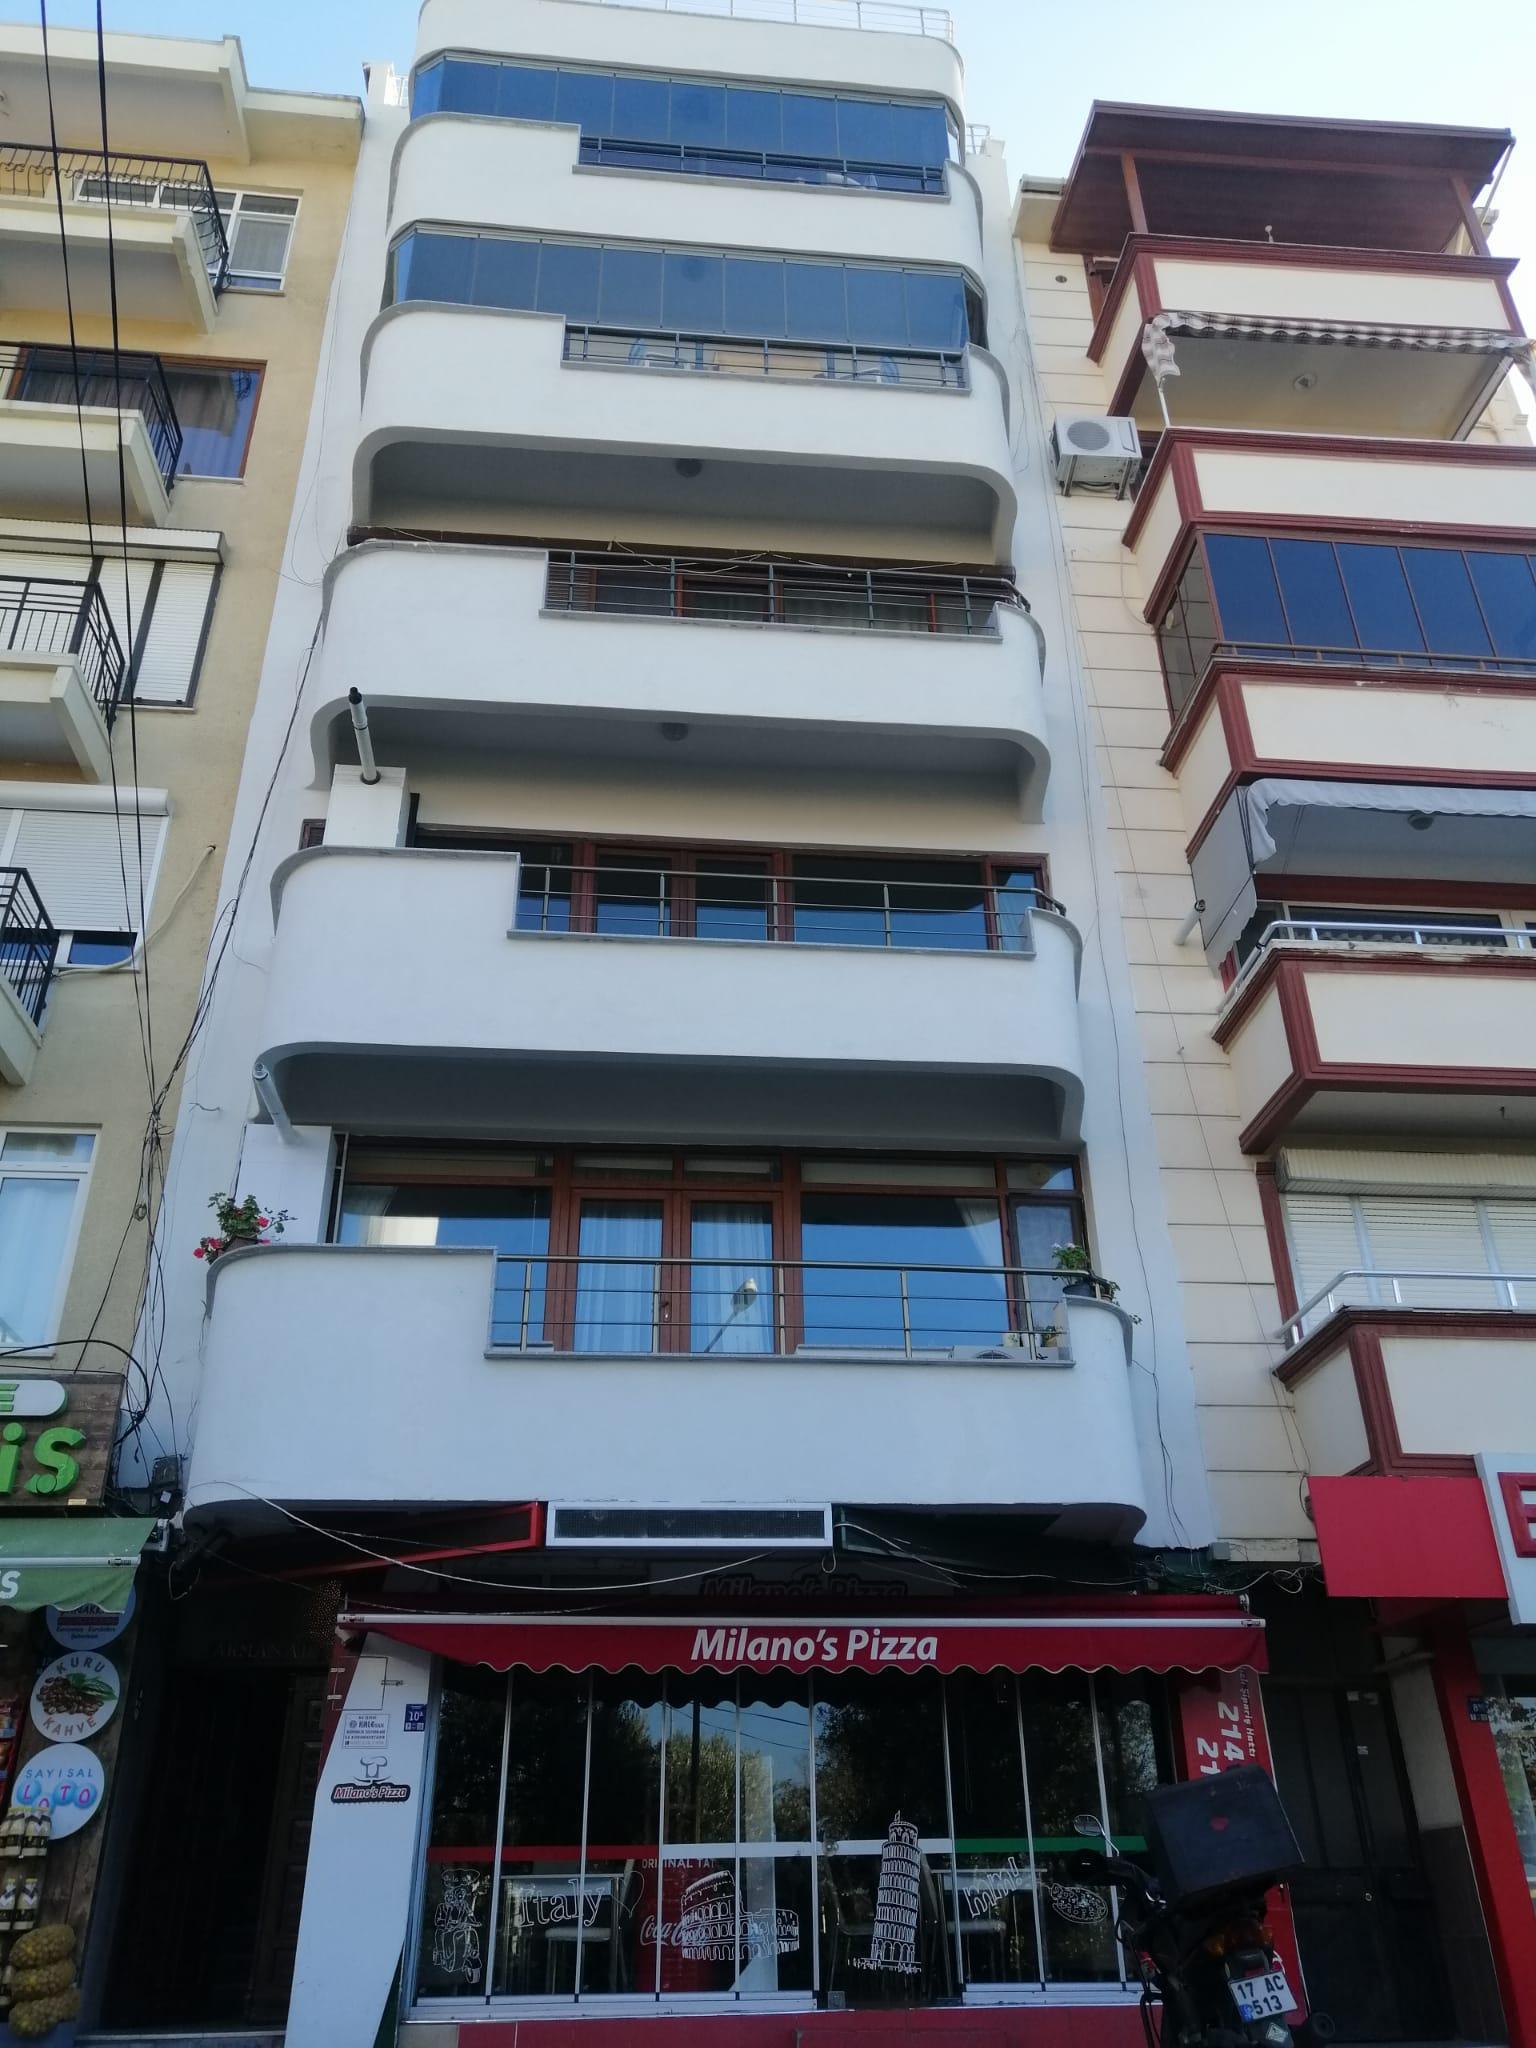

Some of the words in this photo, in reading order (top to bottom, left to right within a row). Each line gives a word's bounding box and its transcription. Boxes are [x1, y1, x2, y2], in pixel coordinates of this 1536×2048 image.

[690, 1628, 838, 1661] Milano's
[847, 1628, 938, 1661] Pizza
[56, 1655, 106, 1674] KURU
[43, 1715, 97, 1737] KAHVE
[1217, 1701, 1245, 1761] 214
[26, 1768, 93, 1779] SAYISAL
[334, 1786, 378, 1799] Milano's
[379, 1785, 407, 1798] Pizza
[642, 1858, 693, 1869] ORIINAL
[520, 1878, 603, 1928] Italy
[1237, 1982, 1254, 1999] 17
[1264, 1975, 1284, 1993] AC
[1252, 1995, 1283, 2015] 513
